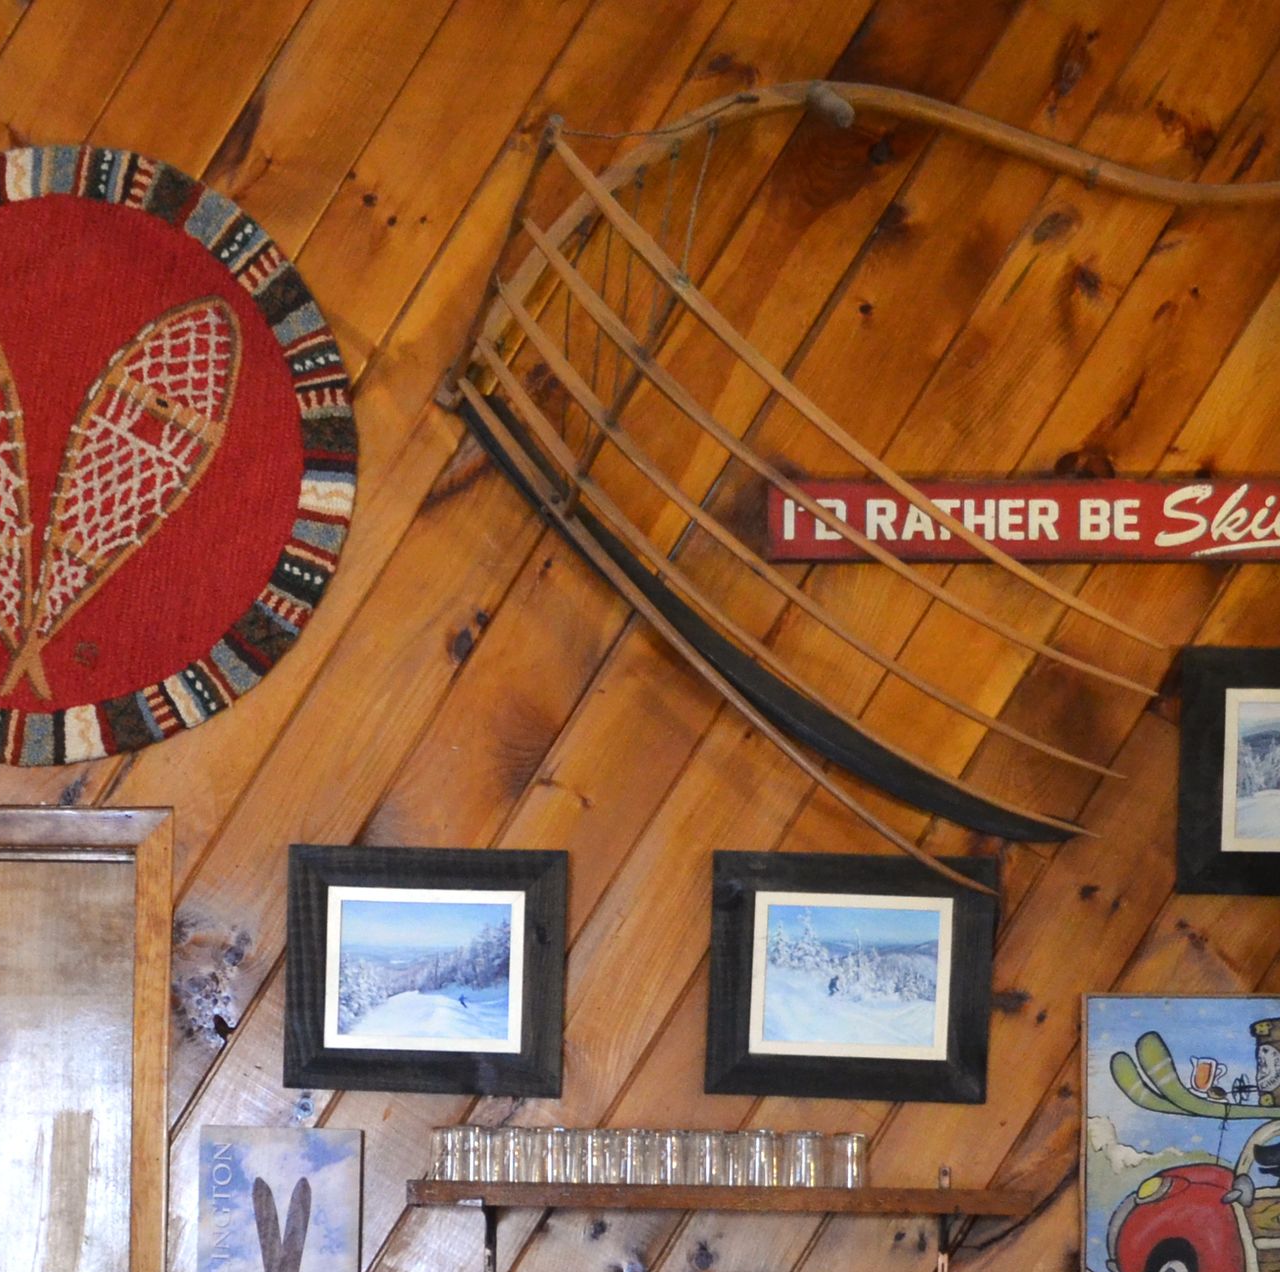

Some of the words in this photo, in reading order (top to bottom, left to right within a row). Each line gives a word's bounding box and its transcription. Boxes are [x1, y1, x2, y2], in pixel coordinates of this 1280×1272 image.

[783, 498, 846, 540] I'D
[866, 498, 1059, 541] RATHER
[1079, 498, 1141, 540] BE
